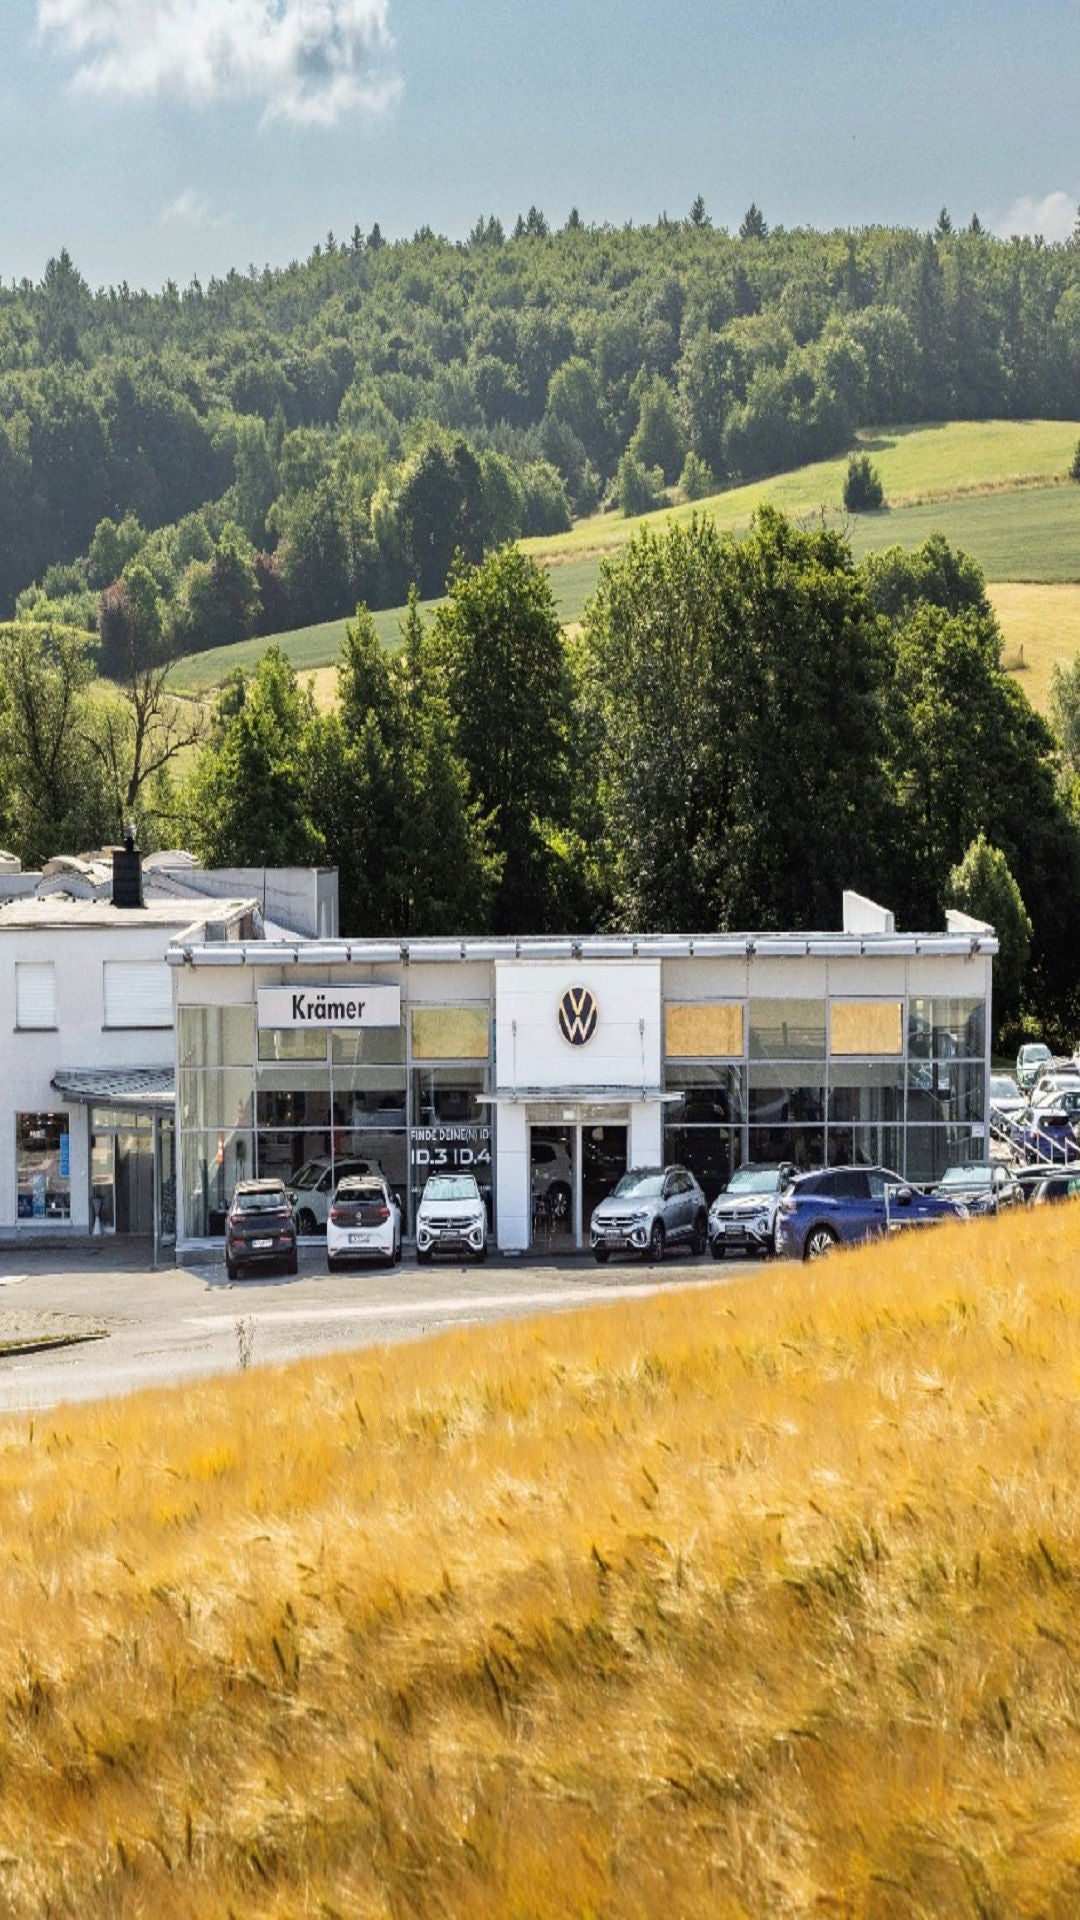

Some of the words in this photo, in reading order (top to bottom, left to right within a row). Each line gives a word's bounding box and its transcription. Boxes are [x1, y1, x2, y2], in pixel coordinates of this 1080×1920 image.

[292, 994, 365, 1020] Krämer
[558, 986, 598, 1044] VW
[411, 1128, 437, 1141] FINDE
[411, 1148, 448, 1165] ID.3
[453, 1148, 491, 1165] ID.4
